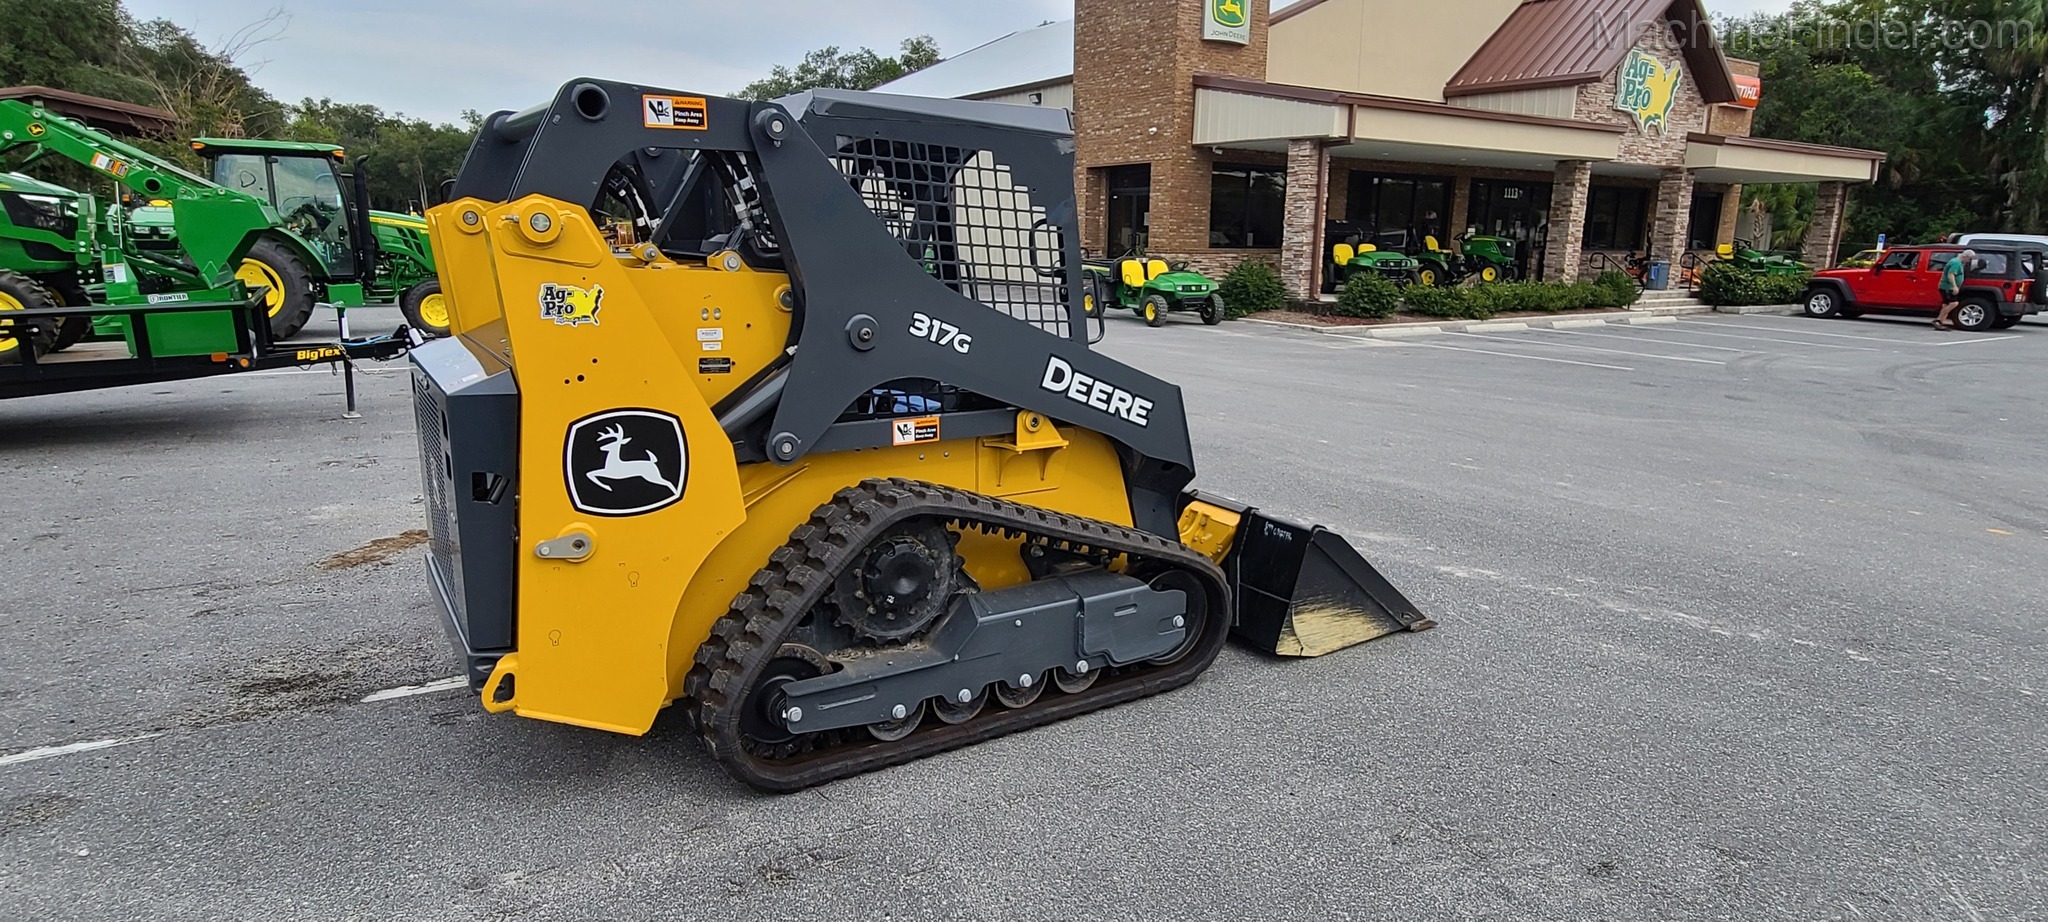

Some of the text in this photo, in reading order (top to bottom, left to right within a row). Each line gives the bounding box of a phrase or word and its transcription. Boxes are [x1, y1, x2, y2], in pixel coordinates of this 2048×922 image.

[1229, 31, 1246, 40] DEERE
[1625, 51, 1654, 86] Ag-
[1621, 79, 1650, 108] Pro
[543, 286, 573, 303] Ag-
[544, 301, 574, 316] Pro
[909, 312, 972, 354] 317G
[296, 347, 341, 361] BigTex
[1041, 356, 1153, 427] DEERE
